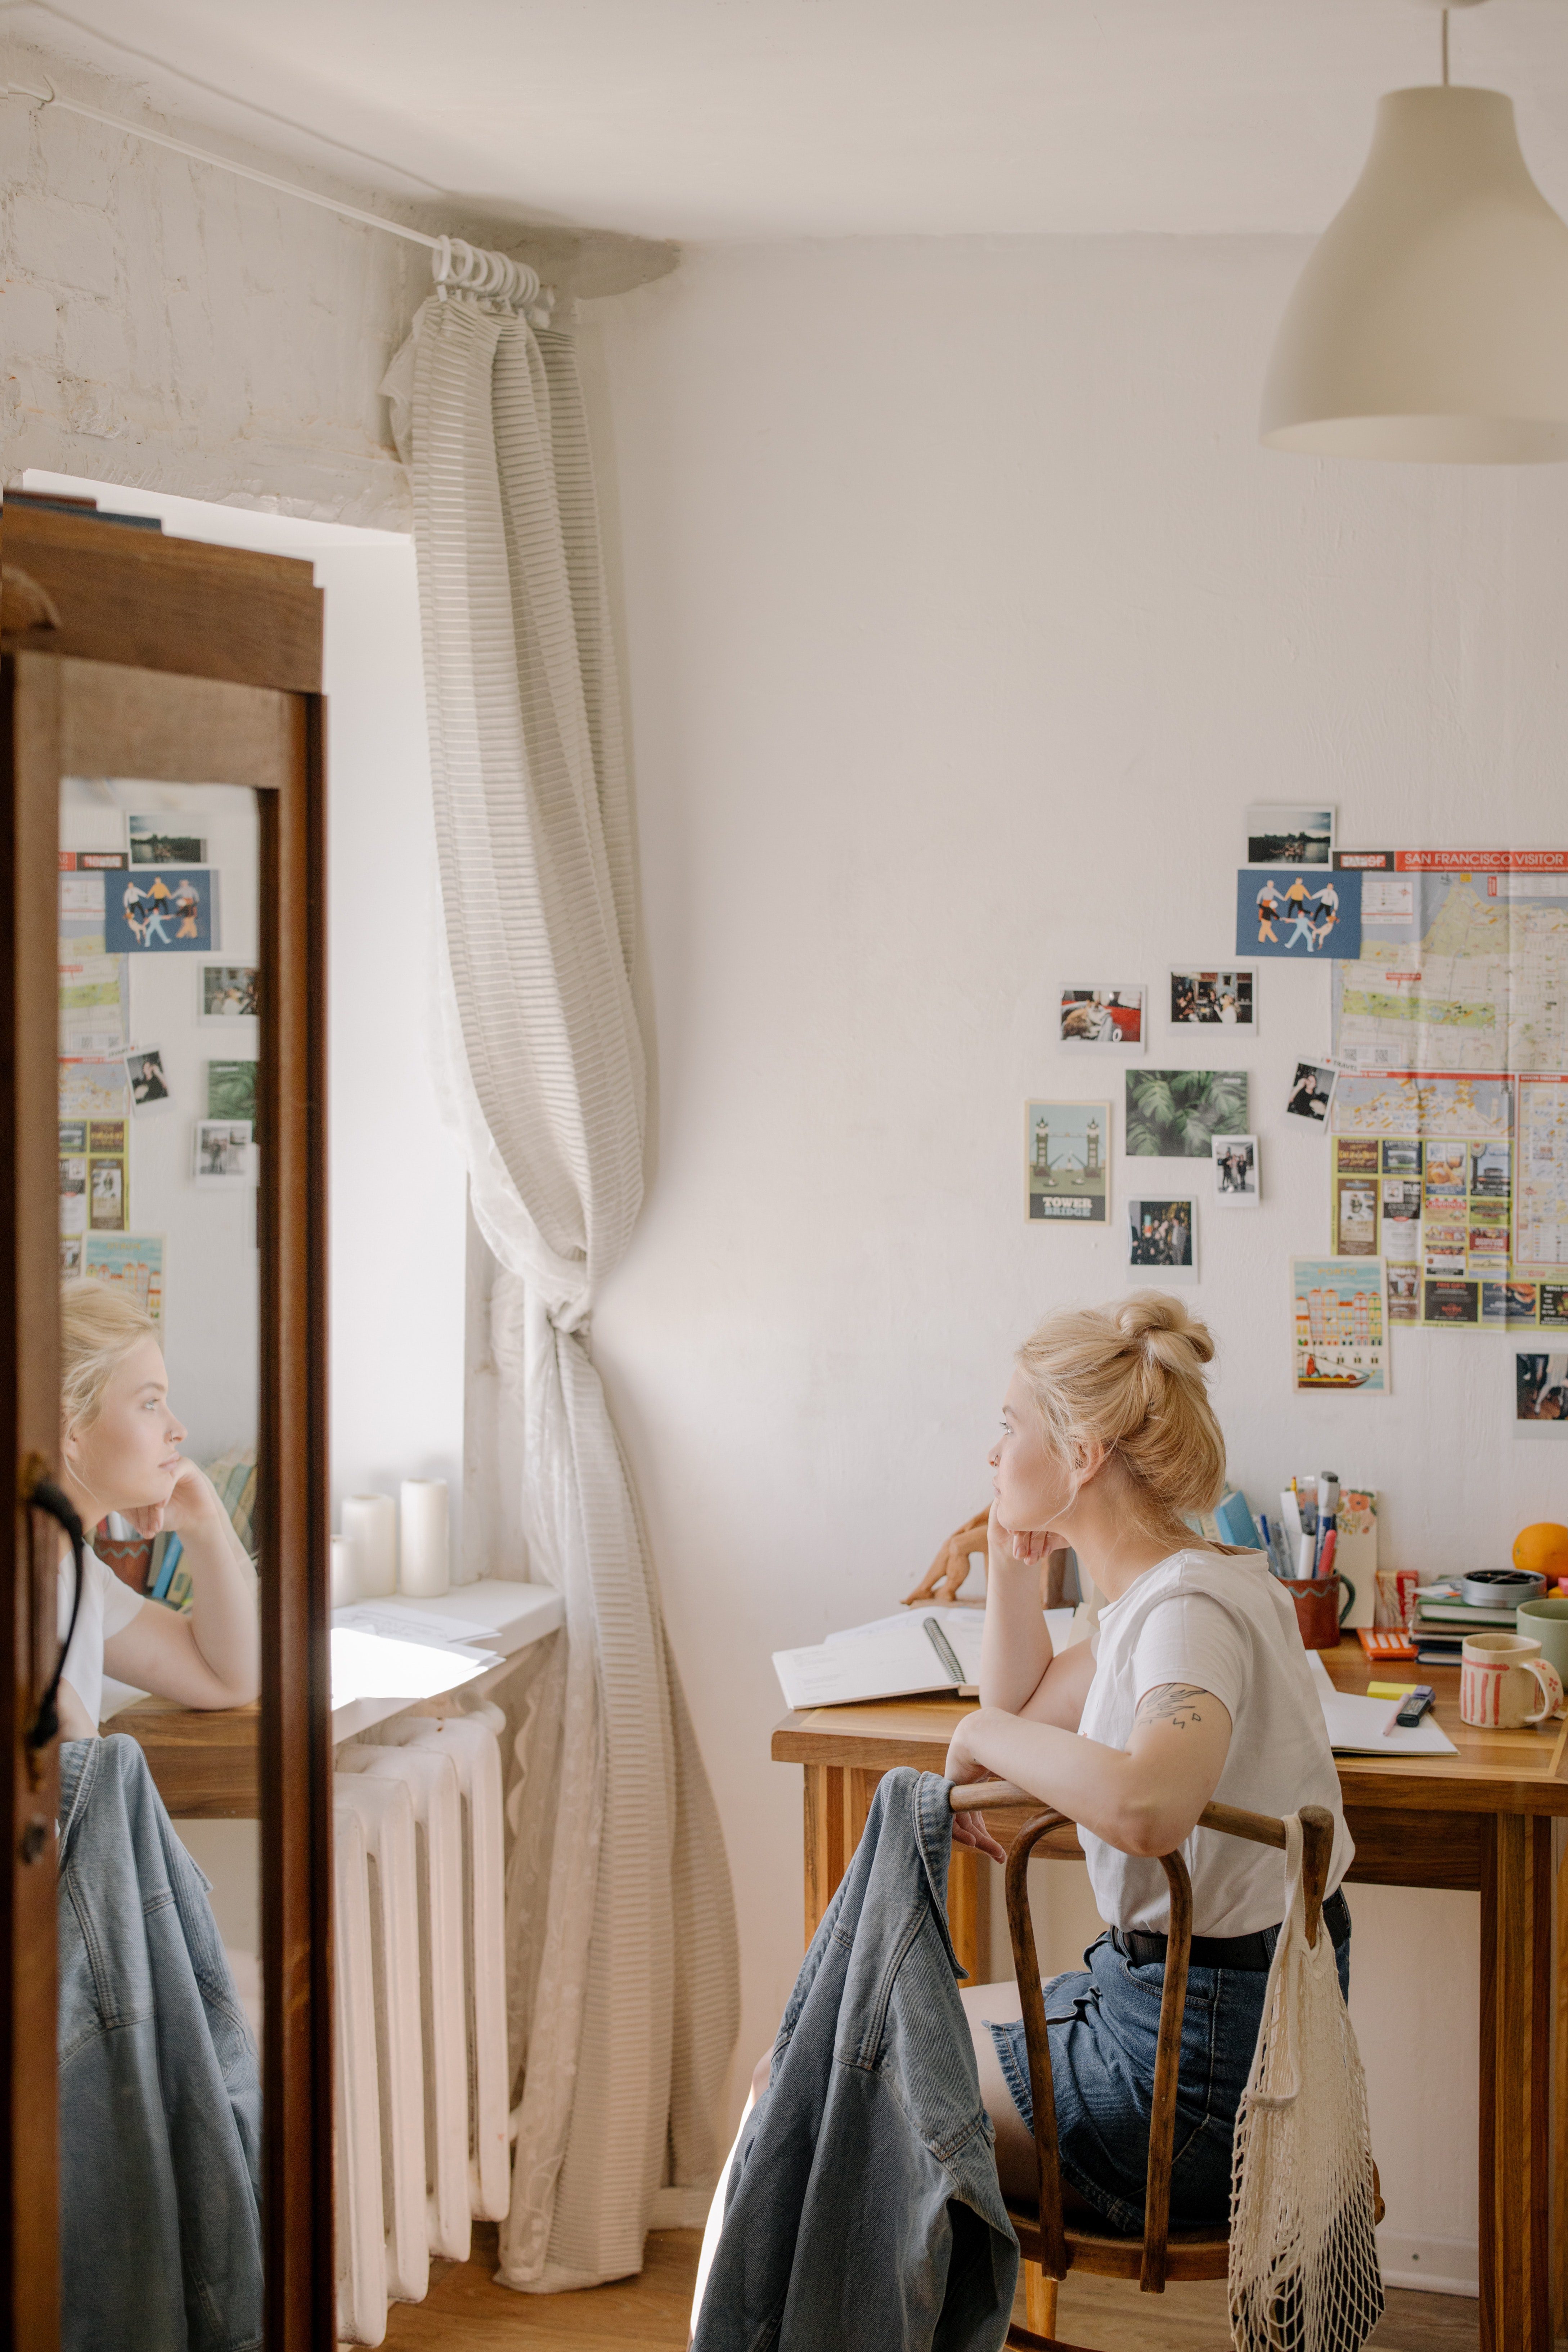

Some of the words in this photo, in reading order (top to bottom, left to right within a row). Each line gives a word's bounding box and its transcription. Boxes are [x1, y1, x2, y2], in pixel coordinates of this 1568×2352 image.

[1405, 853, 1431, 864] SAN
[1434, 853, 1512, 865] FRANCISCO
[1515, 853, 1564, 865] VISITOR
[1333, 1060, 1357, 1073] TRAVEL
[1043, 1197, 1092, 1209] TOWER
[1044, 1207, 1091, 1217] BRIDGE
